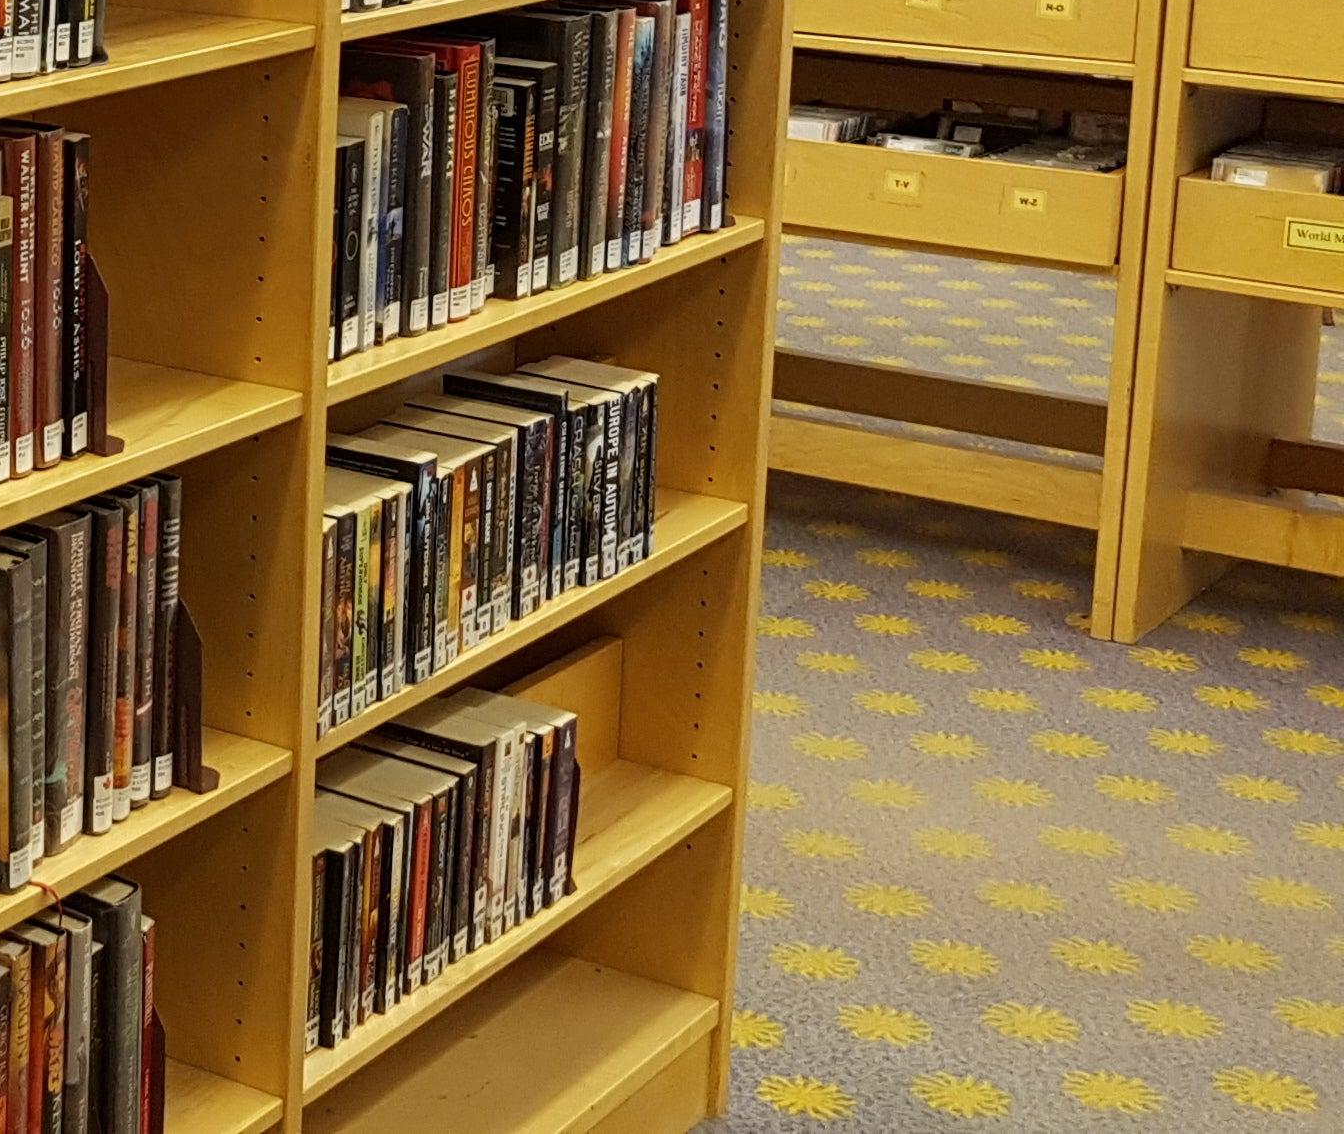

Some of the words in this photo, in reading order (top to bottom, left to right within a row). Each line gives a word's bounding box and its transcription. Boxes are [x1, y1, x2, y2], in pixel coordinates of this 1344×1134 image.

[462, 67, 478, 159] LUMINOUS
[19, 150, 32, 211] WALTER
[20, 217, 30, 233] H.
[1297, 228, 1331, 242] World
[19, 239, 30, 283] HUNT
[605, 397, 620, 457] EUROPE
[605, 461, 619, 475] IN
